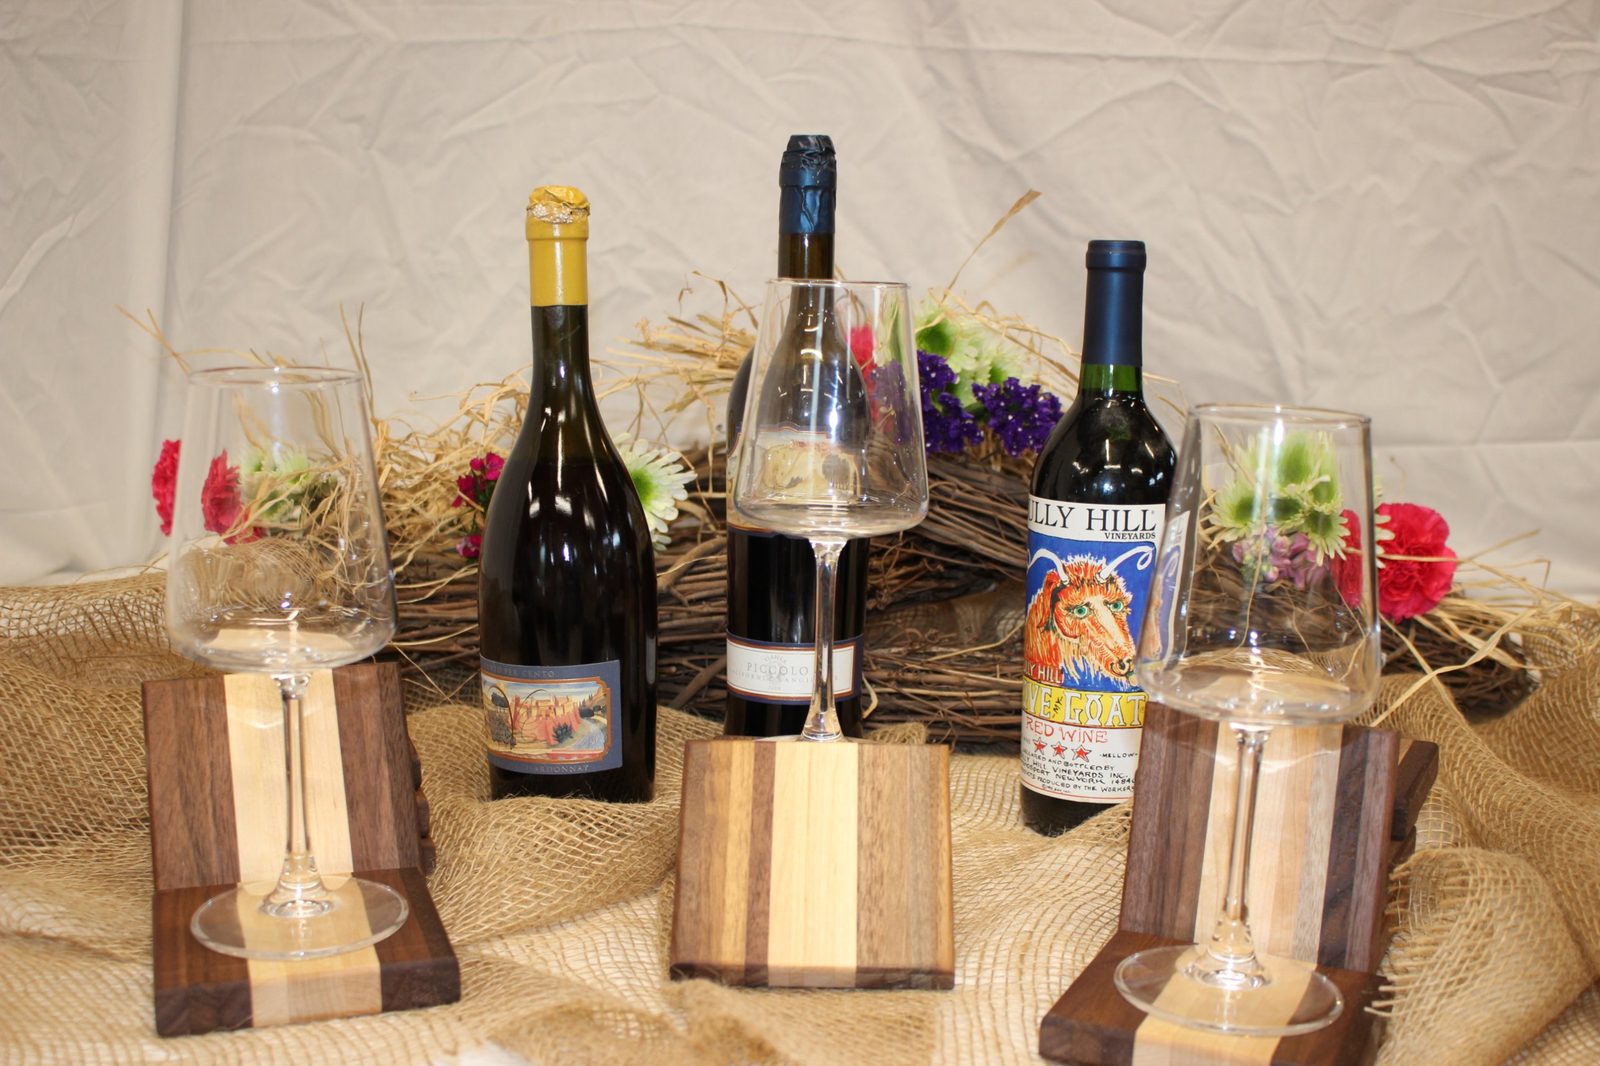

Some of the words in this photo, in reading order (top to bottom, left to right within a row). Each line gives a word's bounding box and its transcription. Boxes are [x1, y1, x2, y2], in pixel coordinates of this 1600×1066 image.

[1086, 508, 1157, 532] HILL
[1104, 532, 1156, 540] VINEYARDS
[746, 662, 809, 676] PICCOLO
[1064, 691, 1146, 727] GOAT
[1026, 716, 1055, 737] RED
[1060, 726, 1109, 744] WINE
[1032, 759, 1047, 770] HILL
[1052, 766, 1104, 779] VINEYARDS
[1037, 776, 1071, 789] PRODUCED
[1055, 773, 1075, 782] NEW
[1076, 776, 1106, 785] YORK
